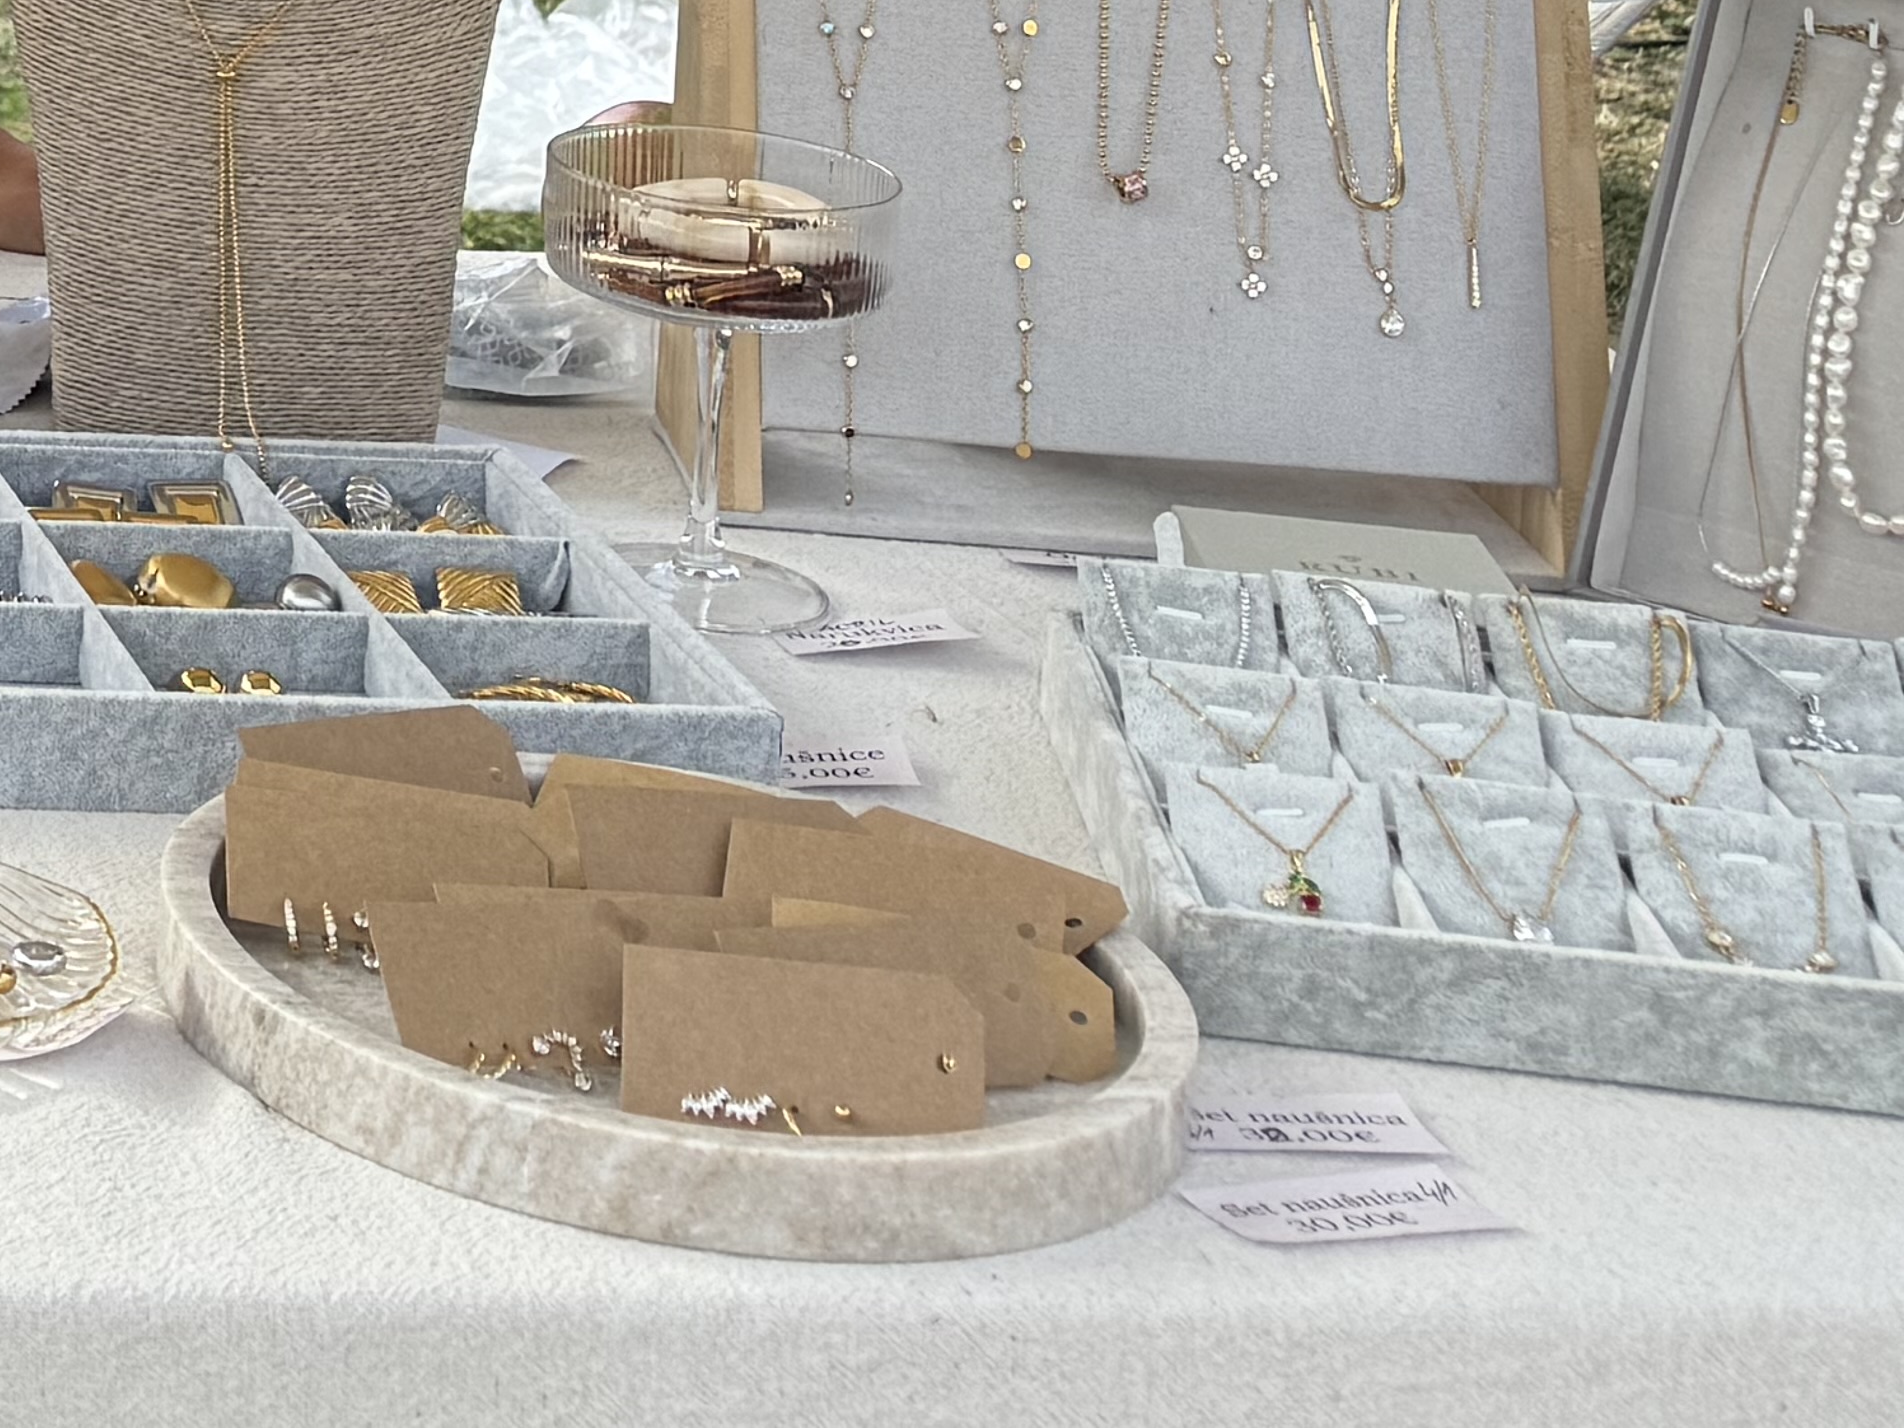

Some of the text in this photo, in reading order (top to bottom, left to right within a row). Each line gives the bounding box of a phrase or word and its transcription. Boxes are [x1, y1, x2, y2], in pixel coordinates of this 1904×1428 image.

[780, 766, 875, 780] 5,00€
[1248, 1107, 1407, 1127] naušnica
[1220, 1199, 1280, 1219] Set
[1280, 1188, 1424, 1216] naušnica
